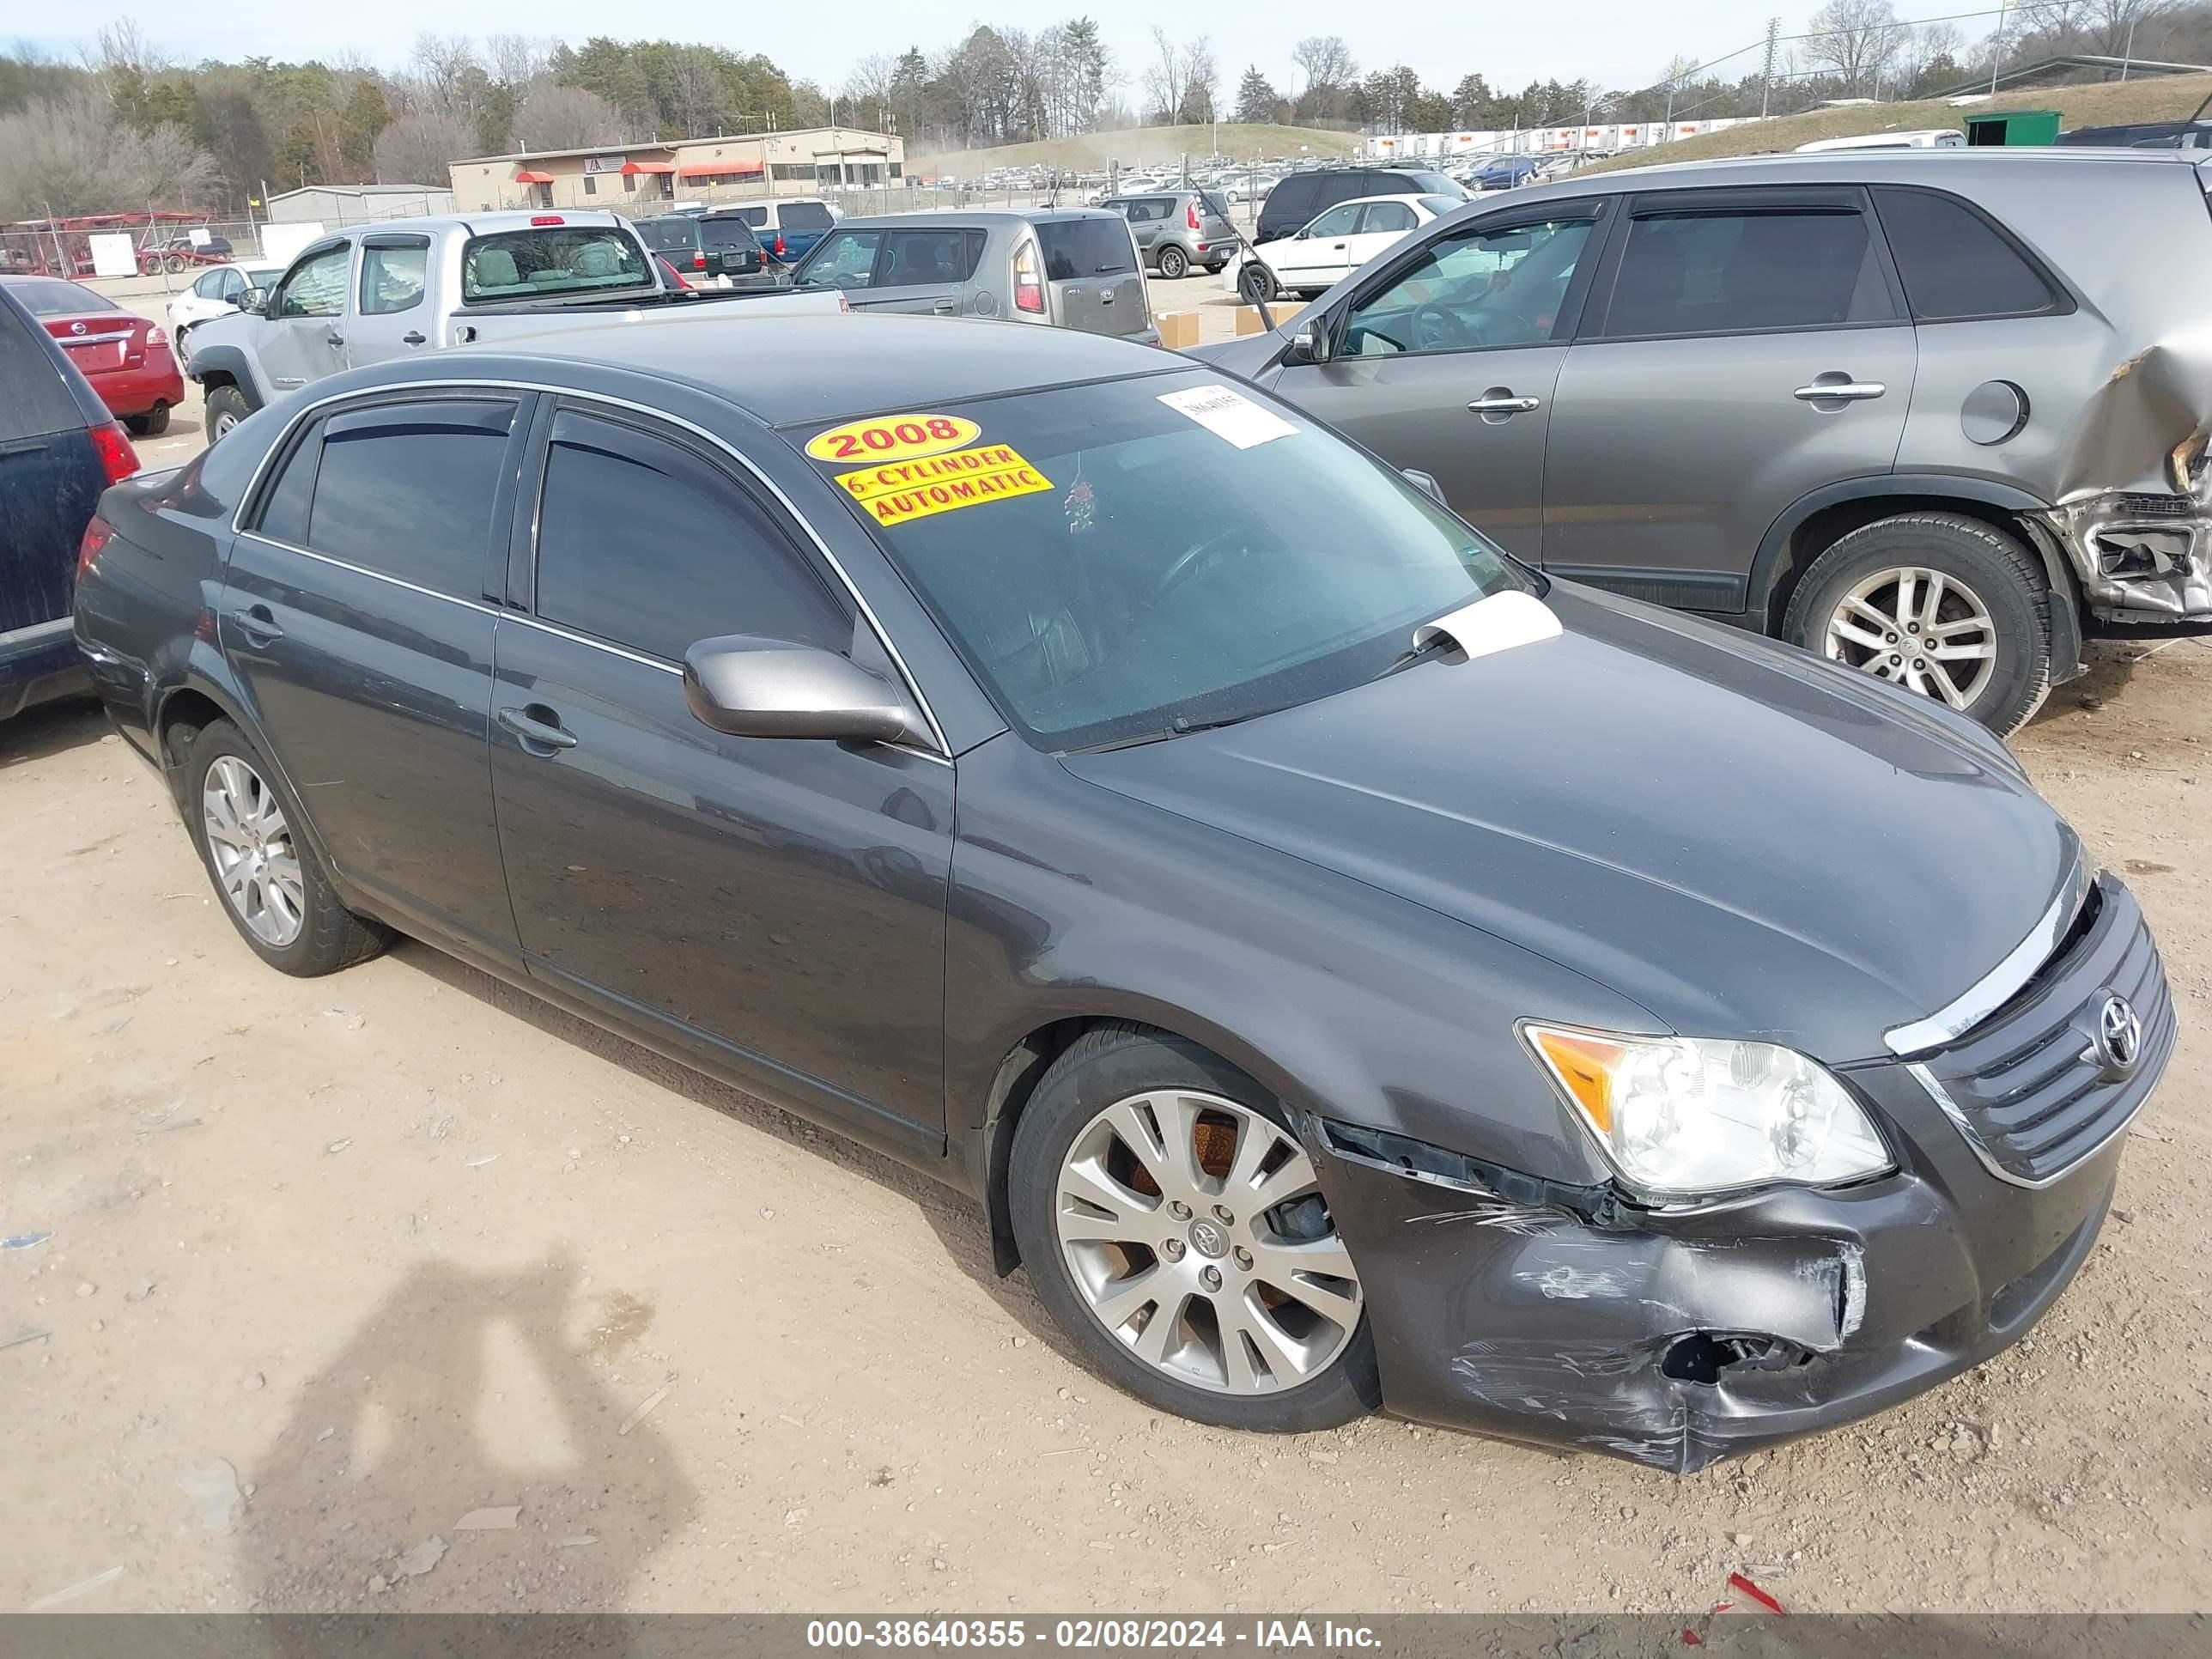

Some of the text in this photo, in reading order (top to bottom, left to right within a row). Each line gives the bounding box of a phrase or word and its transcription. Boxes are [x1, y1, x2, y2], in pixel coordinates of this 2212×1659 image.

[827, 418, 961, 458] 2008
[847, 447, 1016, 494] 6-CYLINDER
[874, 469, 1040, 520] AUTOMATIC
